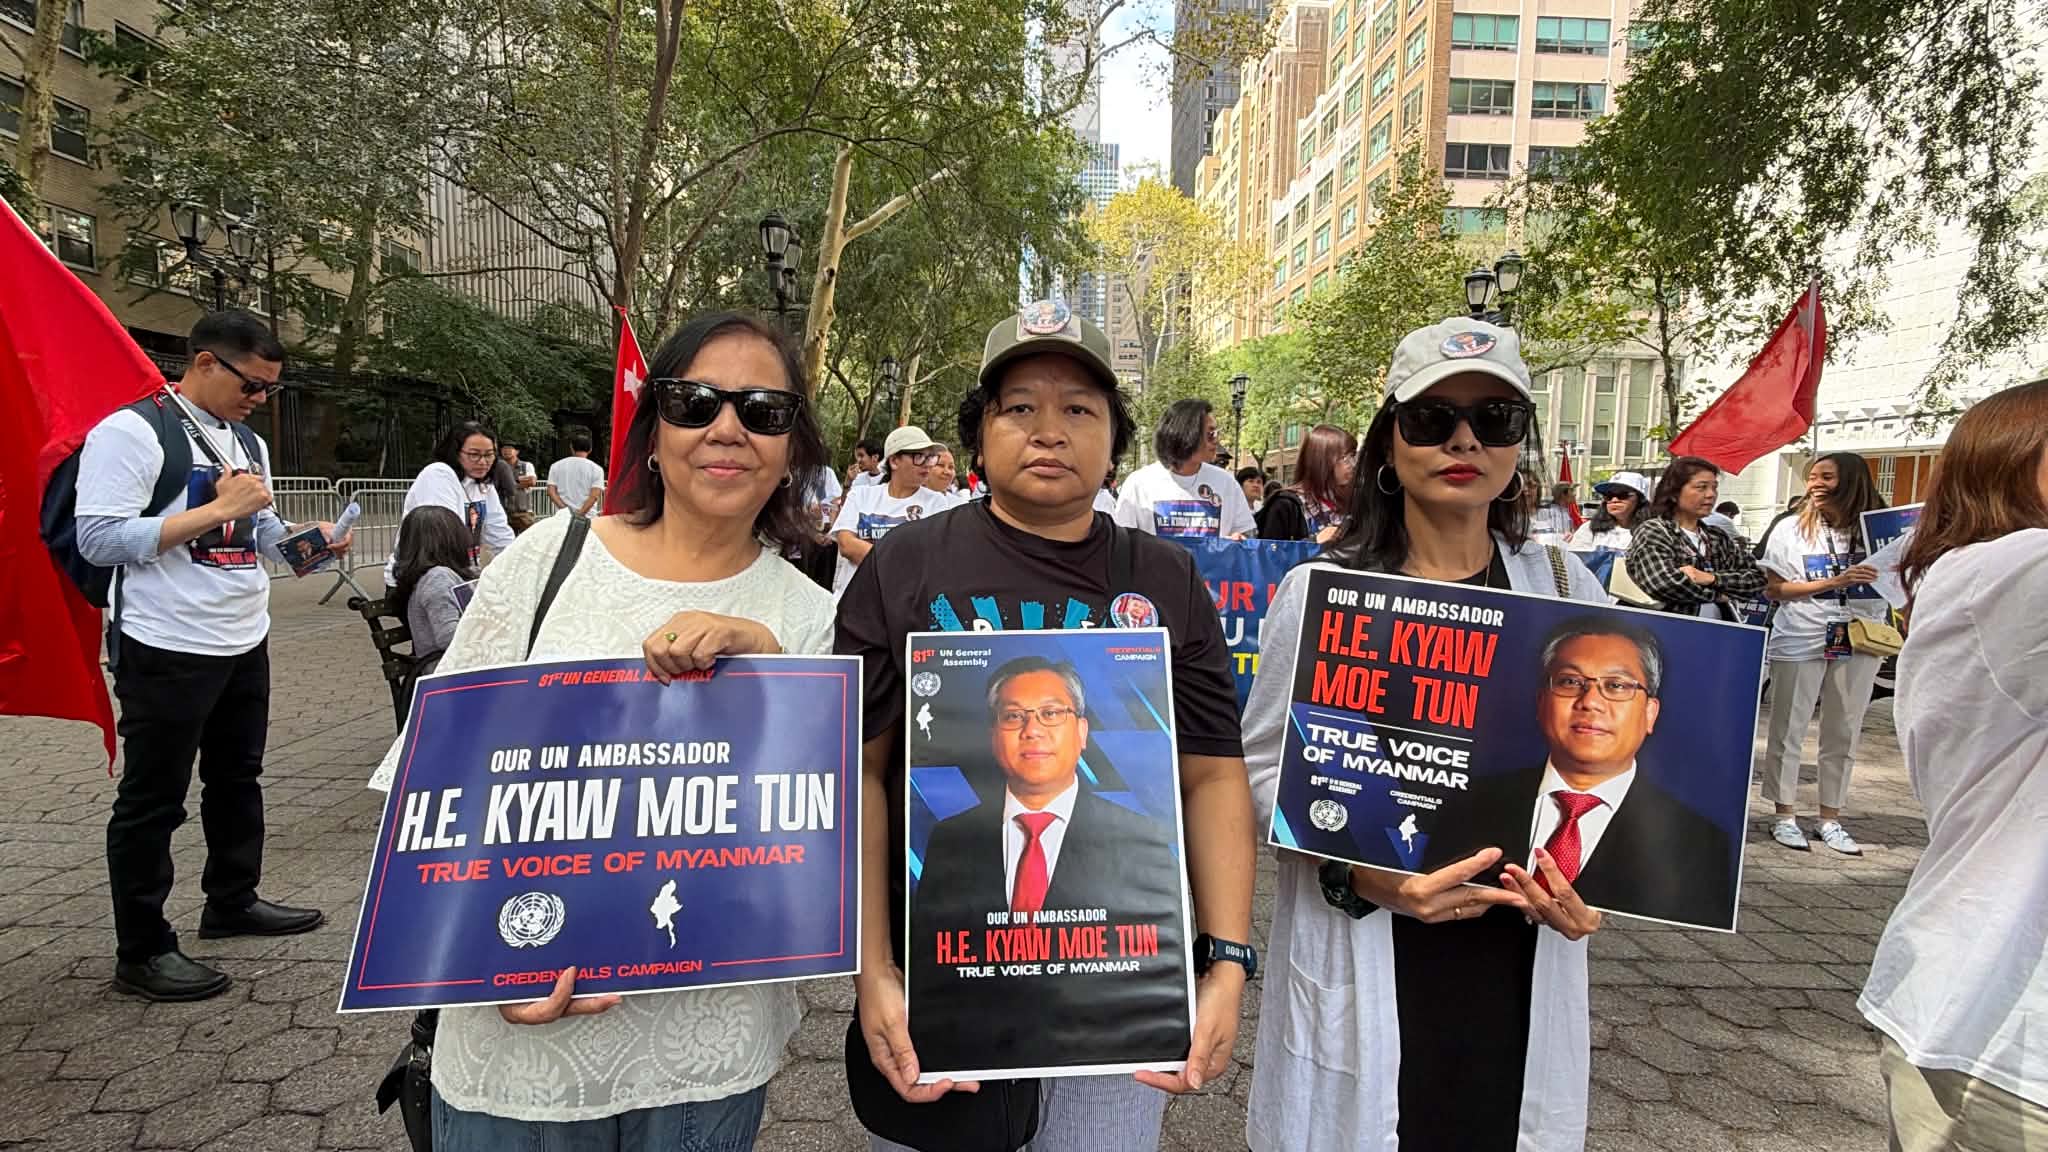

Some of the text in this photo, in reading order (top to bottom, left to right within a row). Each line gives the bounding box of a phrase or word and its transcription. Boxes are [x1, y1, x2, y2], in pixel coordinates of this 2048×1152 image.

[1327, 587, 1505, 627] OUR UN AMBASSADOR
[912, 648, 992, 664] 81ST UN General
[943, 658, 989, 668] Assembly
[1318, 610, 1379, 661] H.E.
[1389, 619, 1499, 678] KYAW
[562, 671, 583, 686] UN
[582, 669, 640, 685] GENERAL
[1311, 660, 1479, 729] MOE TUN
[490, 742, 730, 773] OUR UN AMBASSADOR
[1306, 723, 1471, 769] TRUE VOICE
[1302, 745, 1469, 791] OF MYANMAR
[397, 773, 835, 852] H.E. KYAW MOE TUN
[417, 845, 805, 884] TRUE VOICE OF MYANMAR
[987, 908, 1107, 925] OUR UN AMBASSADOR
[936, 923, 1158, 964] H.E. KYAW MOE TUN
[493, 960, 703, 987] CREDENALS CAMPAIGN
[957, 960, 1141, 979] TRUE VOICE OF MYANMAR
